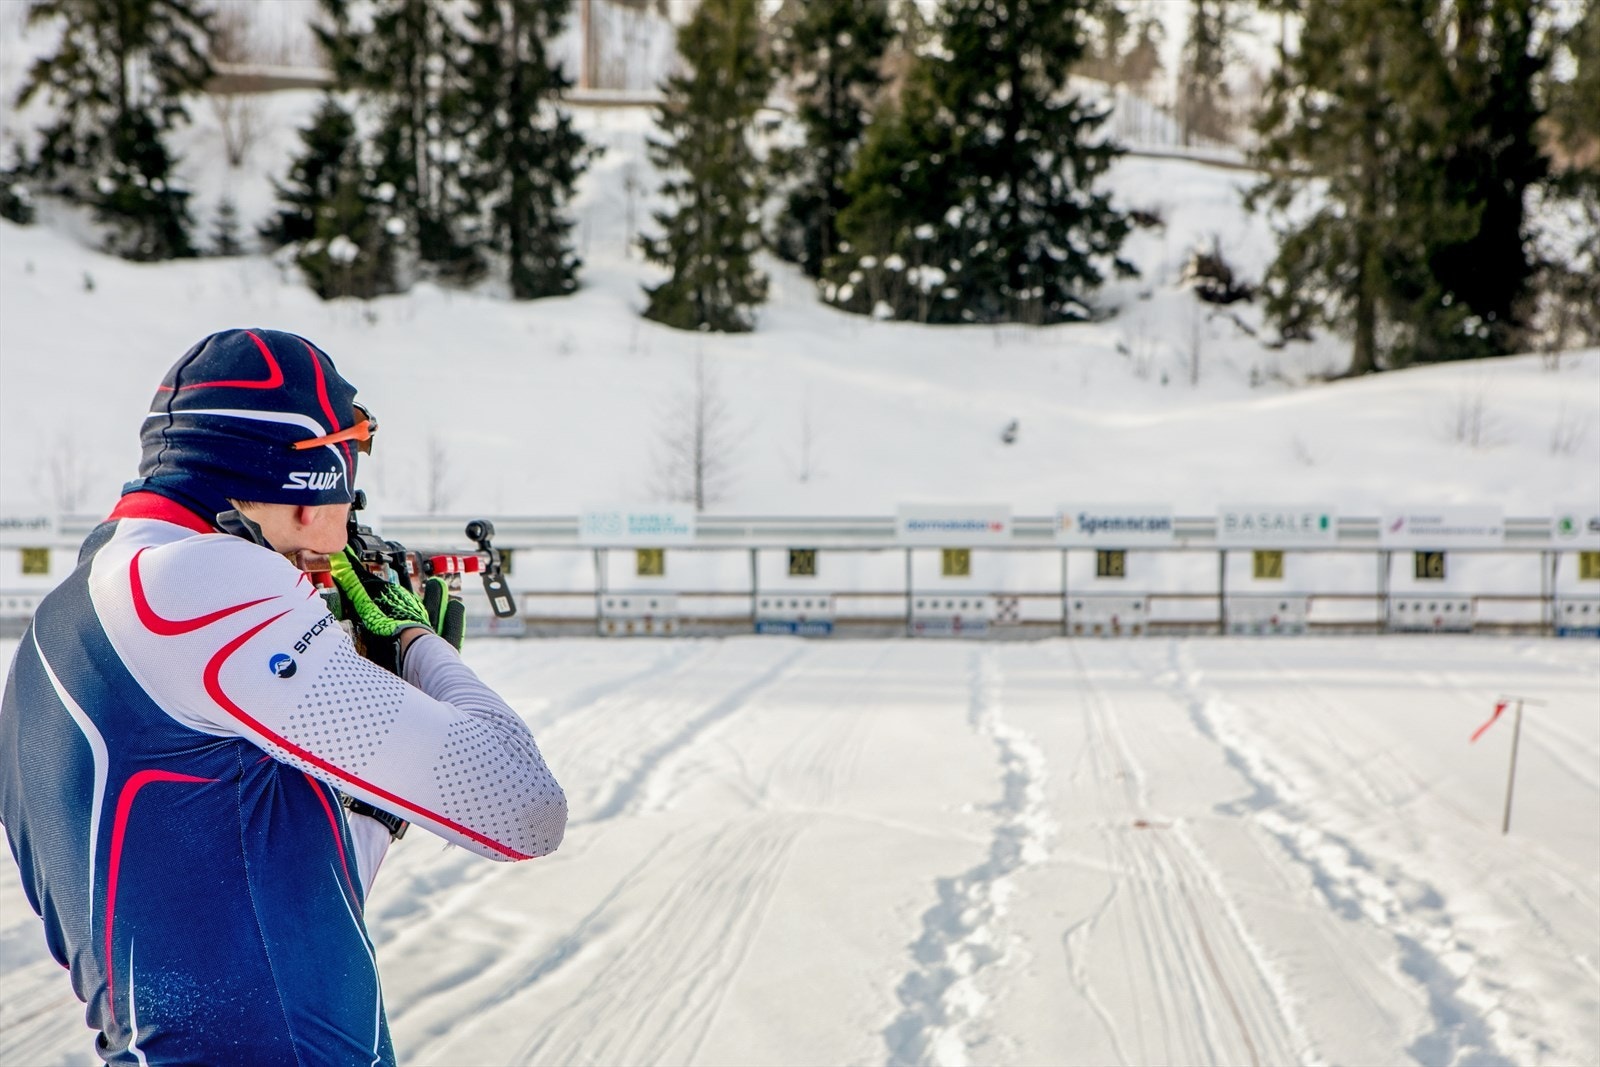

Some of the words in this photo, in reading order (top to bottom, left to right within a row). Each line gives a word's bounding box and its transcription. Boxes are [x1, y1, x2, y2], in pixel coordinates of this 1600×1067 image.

[1225, 514, 1312, 530] BASALE
[789, 549, 815, 575] 20
[944, 550, 970, 575] 19
[1098, 551, 1124, 577] 18
[1255, 552, 1282, 578] 17
[1416, 552, 1444, 578] 16
